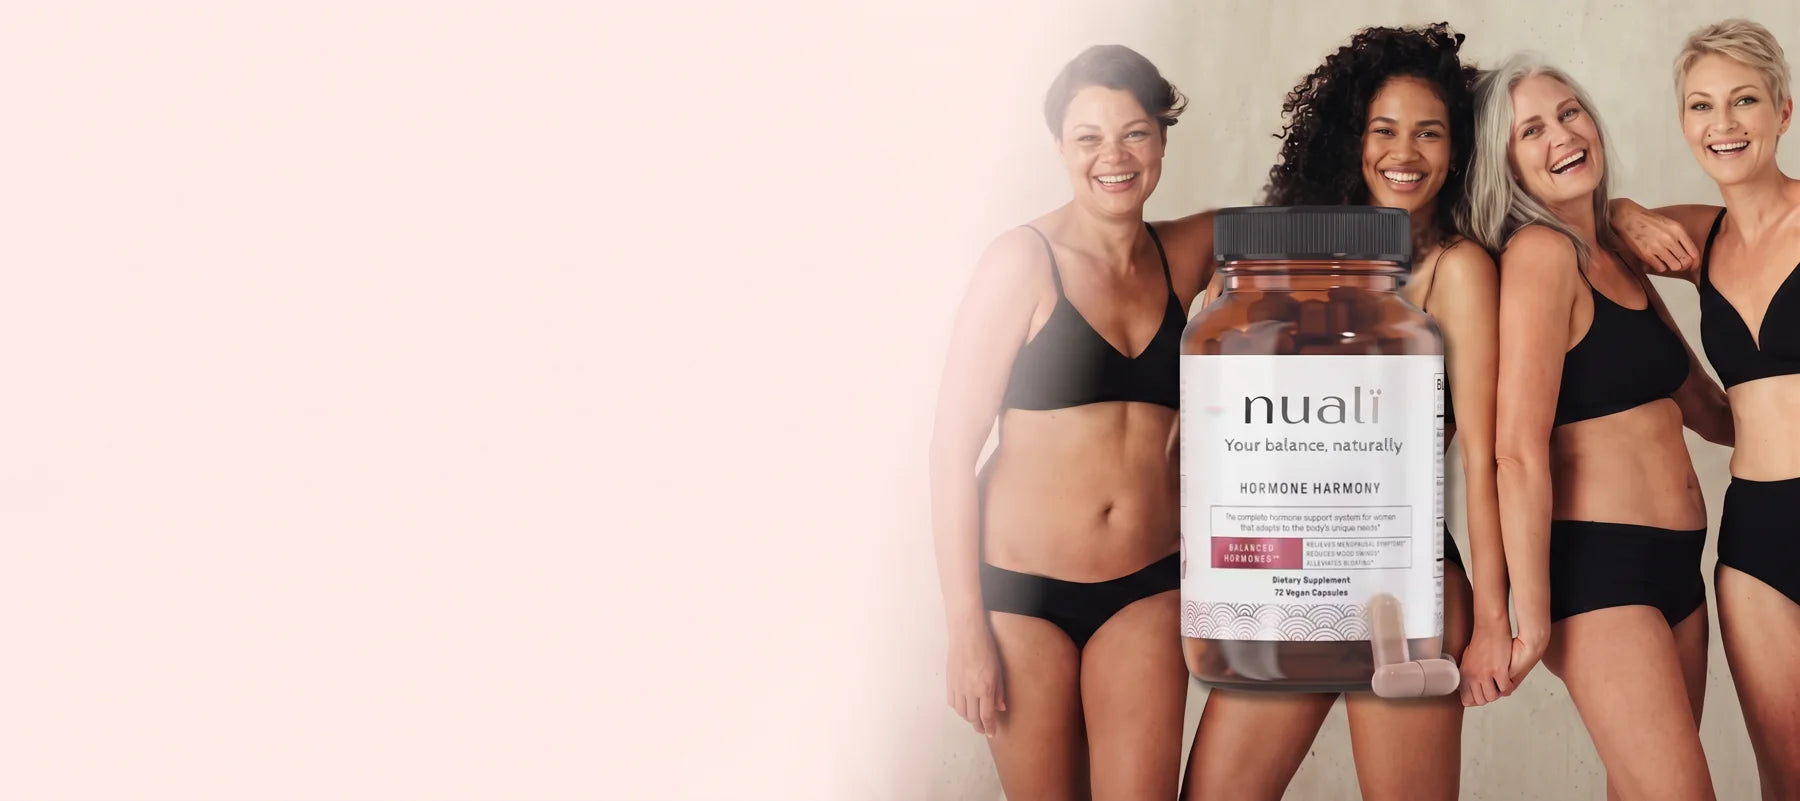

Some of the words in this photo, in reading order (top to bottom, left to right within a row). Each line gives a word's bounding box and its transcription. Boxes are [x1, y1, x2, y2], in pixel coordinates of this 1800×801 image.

[1225, 438, 1260, 452] Your
[1265, 437, 1328, 453] balance,
[1333, 438, 1403, 455] naturally
[1240, 482, 1307, 494] HORMONE
[1313, 482, 1380, 494] HARMONY
[1304, 514, 1332, 522] support
[1335, 514, 1360, 522] system
[1256, 524, 1280, 532] adapts
[1229, 544, 1274, 552] BALANCED
[1272, 576, 1301, 585] Dietary
[1303, 576, 1351, 585] Supplement
[1286, 589, 1310, 598] Vegan
[1312, 589, 1349, 597] Capsules
